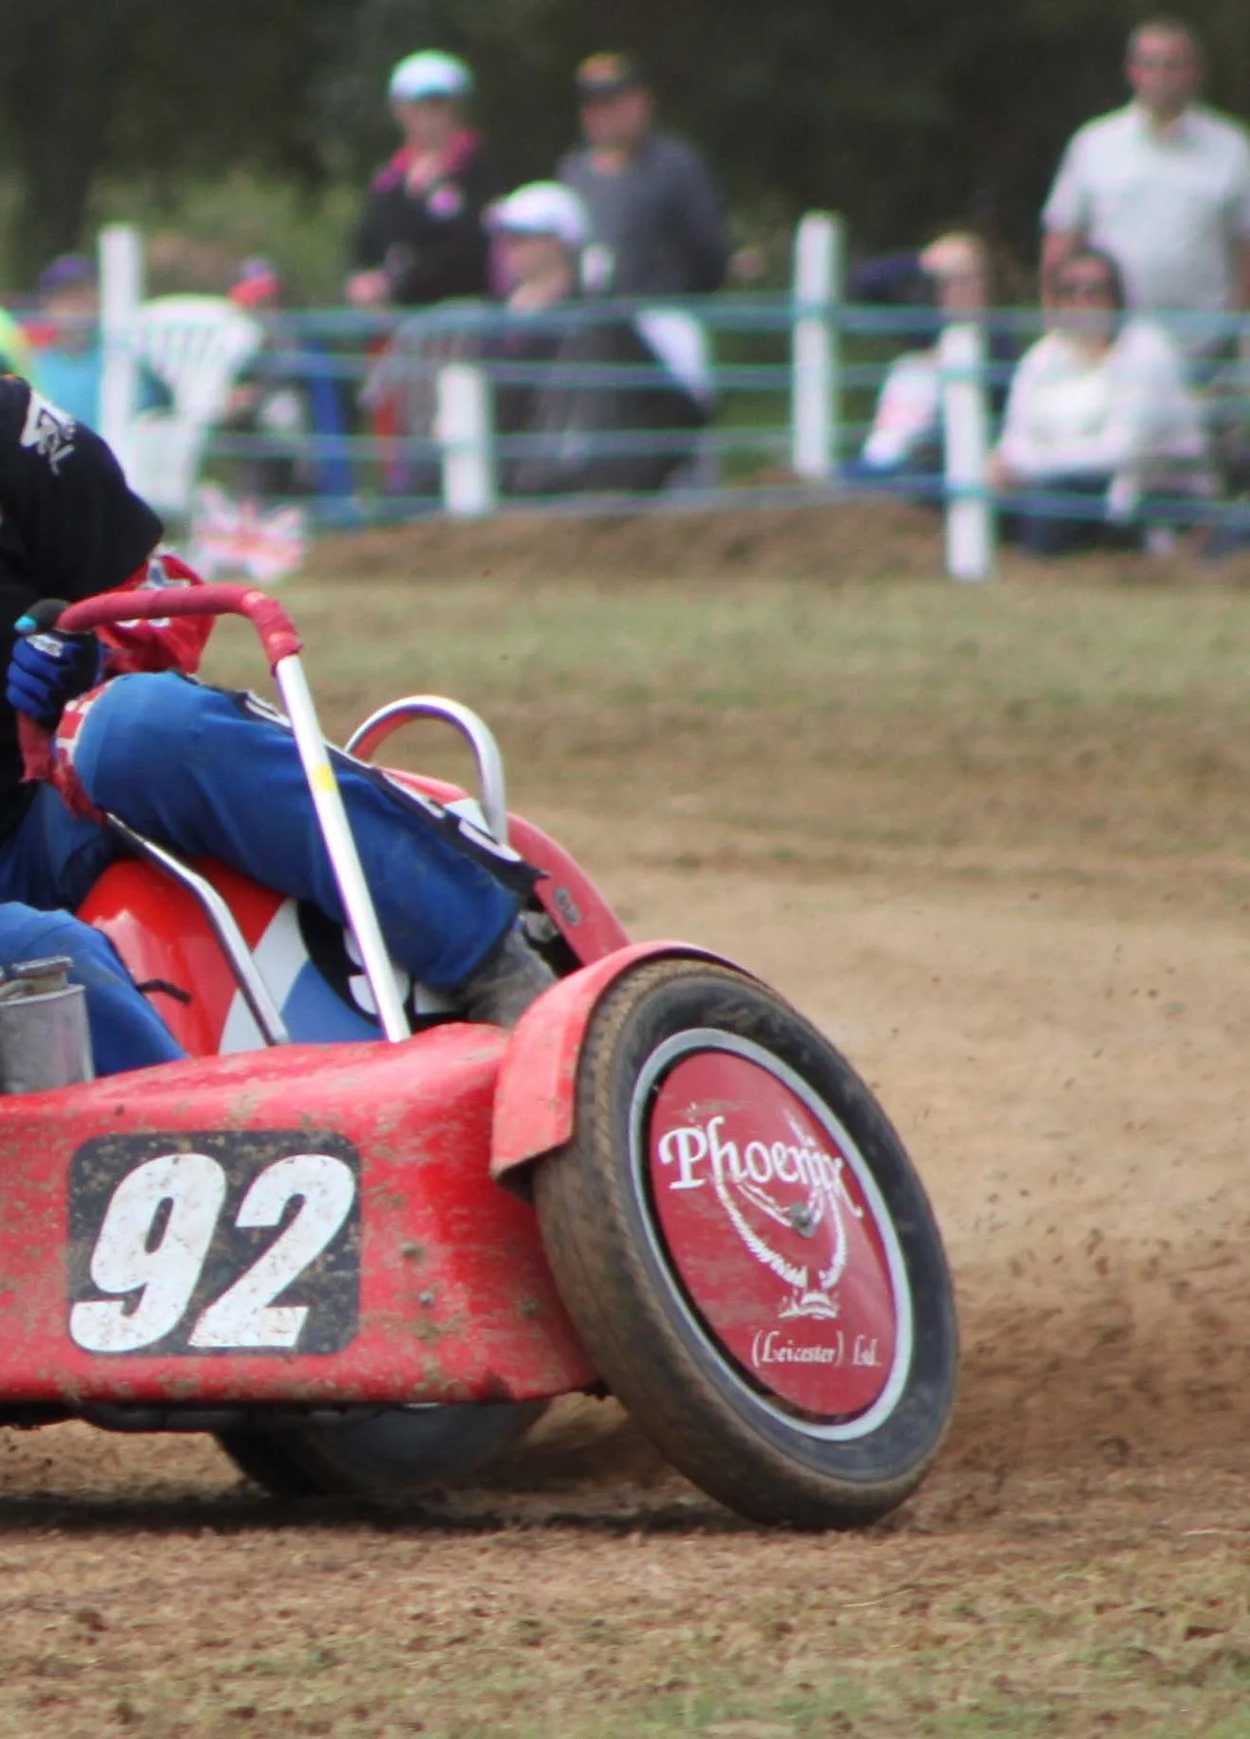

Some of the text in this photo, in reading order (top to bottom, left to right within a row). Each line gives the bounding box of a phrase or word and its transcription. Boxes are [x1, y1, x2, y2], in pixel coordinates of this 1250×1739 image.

[658, 1116, 863, 1218] Phoenix
[69, 1152, 356, 1352] 92
[751, 1329, 845, 1368] (Leicester)
